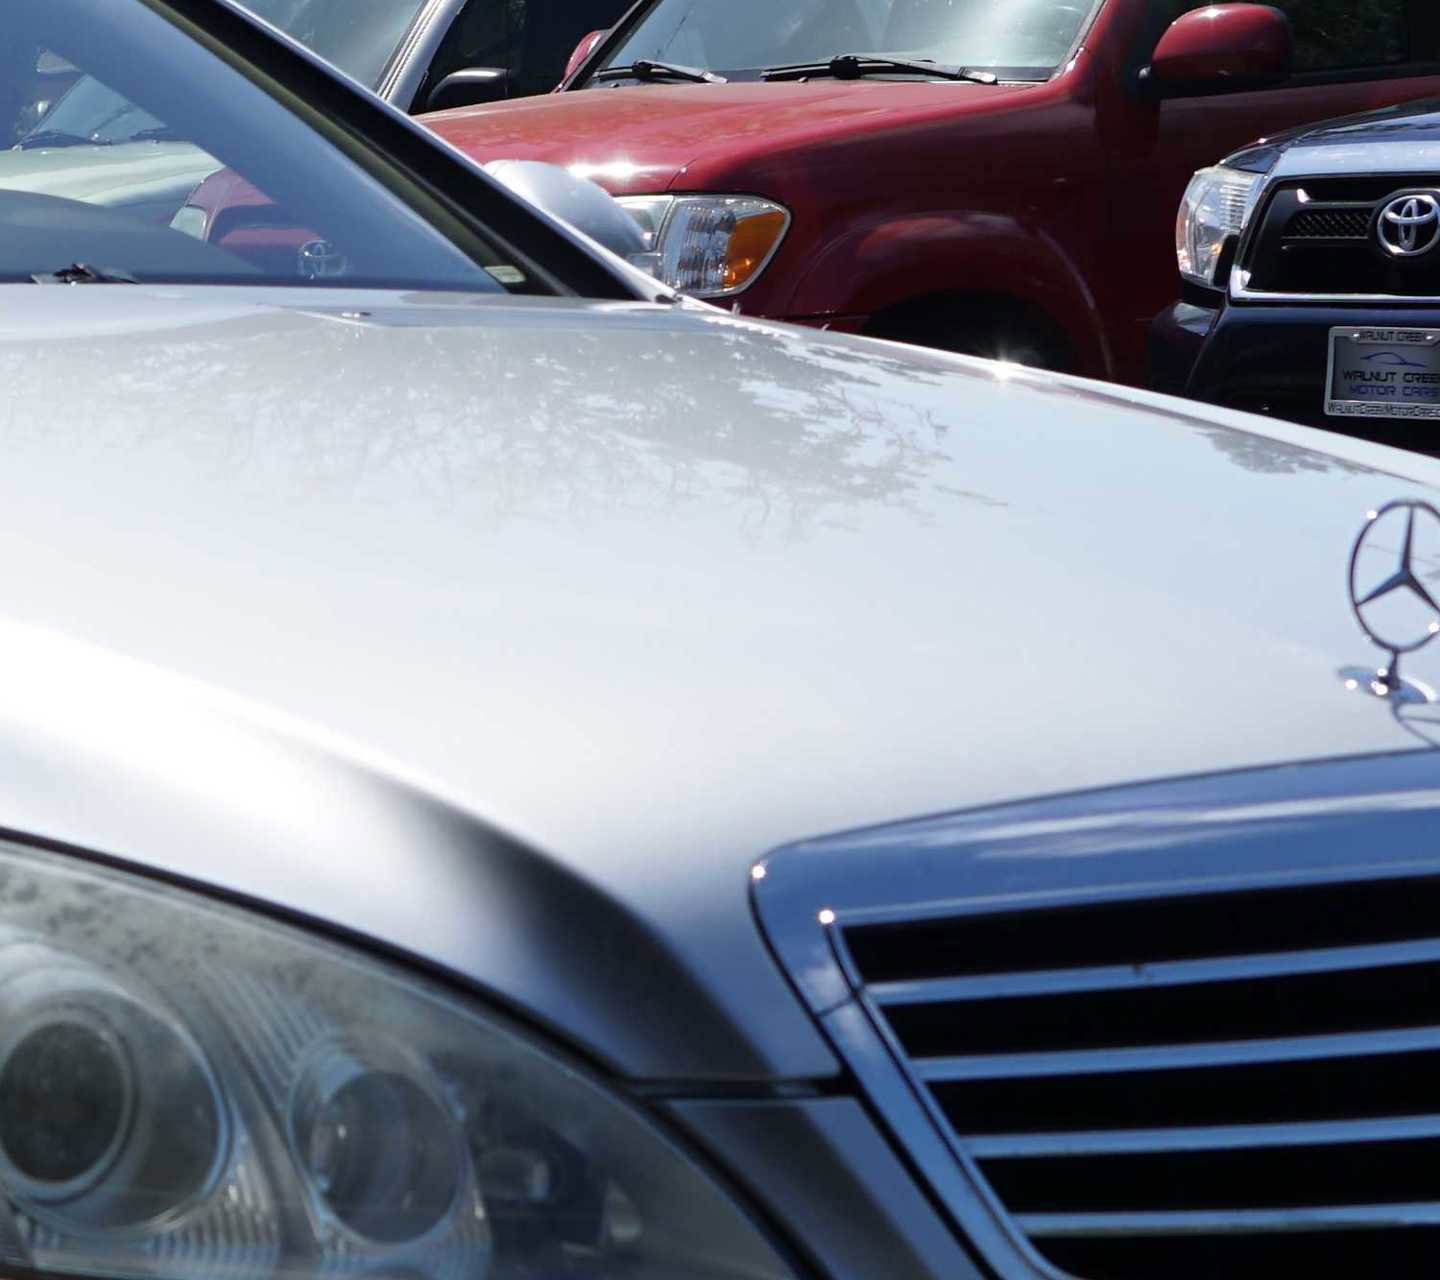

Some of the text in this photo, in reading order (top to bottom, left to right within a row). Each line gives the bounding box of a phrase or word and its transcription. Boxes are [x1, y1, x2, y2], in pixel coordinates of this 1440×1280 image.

[1343, 370, 1396, 383] WALNUT
[1350, 384, 1440, 397] MOTOR CARS
